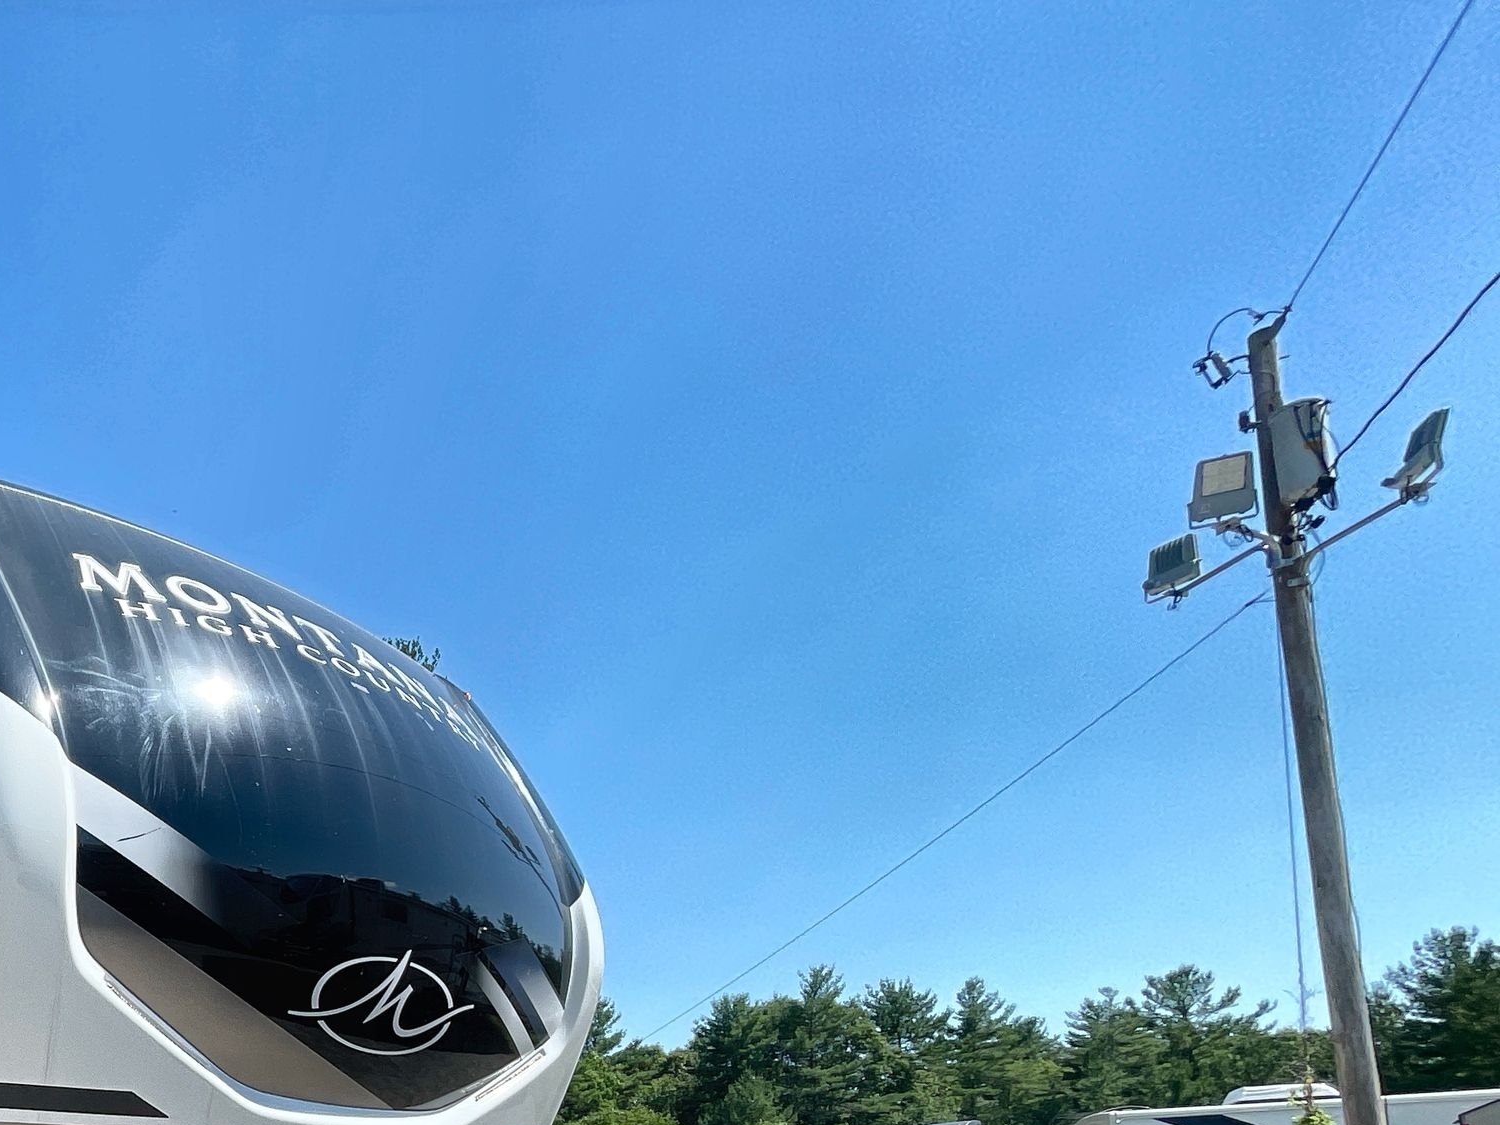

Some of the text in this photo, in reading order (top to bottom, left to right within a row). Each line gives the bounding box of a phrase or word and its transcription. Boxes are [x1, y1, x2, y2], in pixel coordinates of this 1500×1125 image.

[72, 552, 486, 746] MONTANA
[113, 597, 481, 752] HIGH COUNTRY
